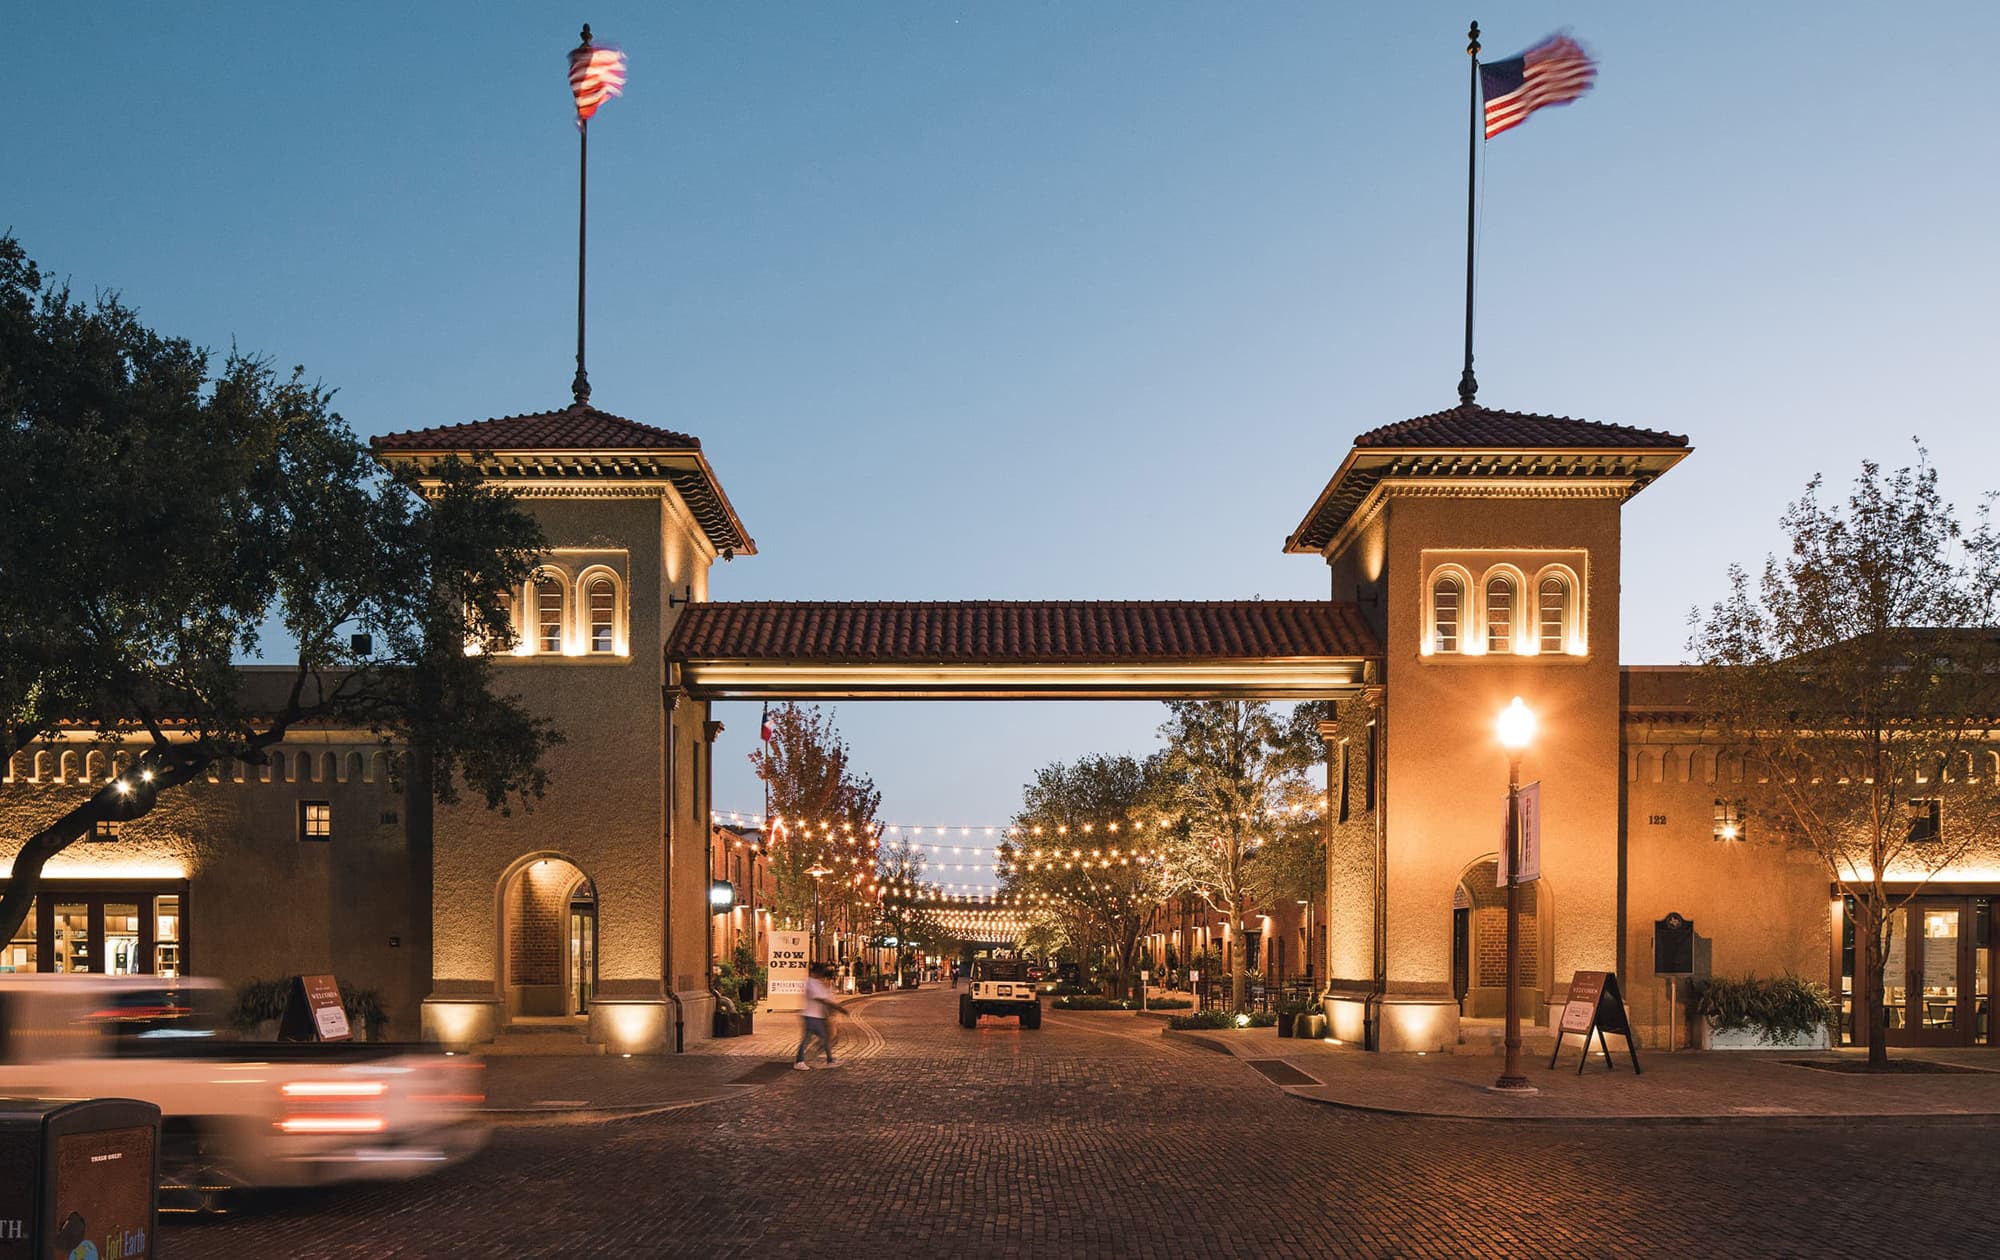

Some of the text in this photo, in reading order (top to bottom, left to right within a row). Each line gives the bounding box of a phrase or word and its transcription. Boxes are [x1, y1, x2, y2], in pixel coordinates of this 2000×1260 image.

[1649, 815, 1667, 825] 122
[773, 951, 805, 959] NOW
[770, 960, 808, 969] OPEN
[106, 1226, 145, 1260] Fort Earth
